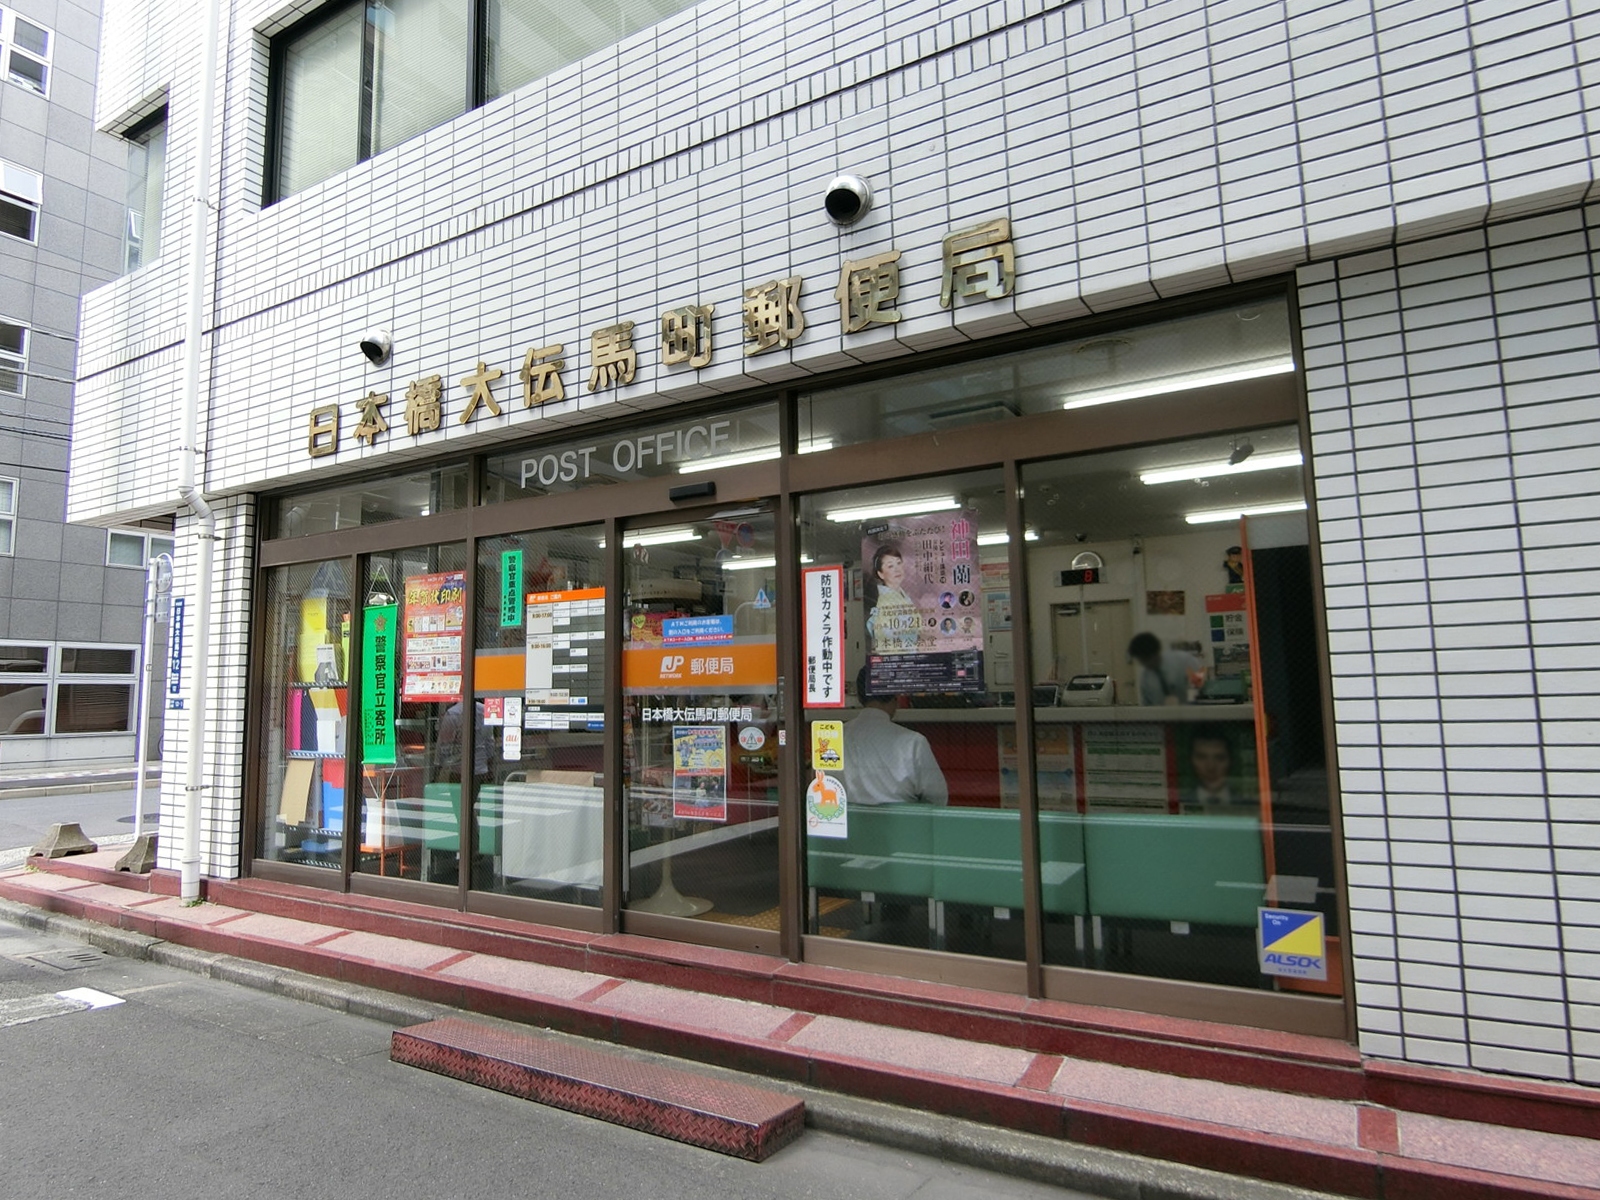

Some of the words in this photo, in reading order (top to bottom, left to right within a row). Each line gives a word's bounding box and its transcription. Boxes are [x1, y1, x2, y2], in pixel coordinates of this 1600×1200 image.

[308, 217, 1016, 458] 日本橋大伝馬町郵便局
[520, 446, 597, 489] POST
[612, 421, 732, 474] OFFICE
[950, 518, 970, 560] 神田
[922, 539, 934, 585] 田中絹代
[408, 587, 463, 607] 年賀状印刷
[820, 574, 833, 699] 防犯カメラ作動中です
[1225, 613, 1243, 622] 貯金
[690, 656, 734, 675] 郵便局
[808, 655, 816, 693] 郵便局長
[374, 636, 387, 746] 警察官立寄所
[641, 707, 753, 722] 日本橋大伝馬町郵便局
[1264, 913, 1289, 921] Security
[1264, 953, 1322, 969] ALSOK
